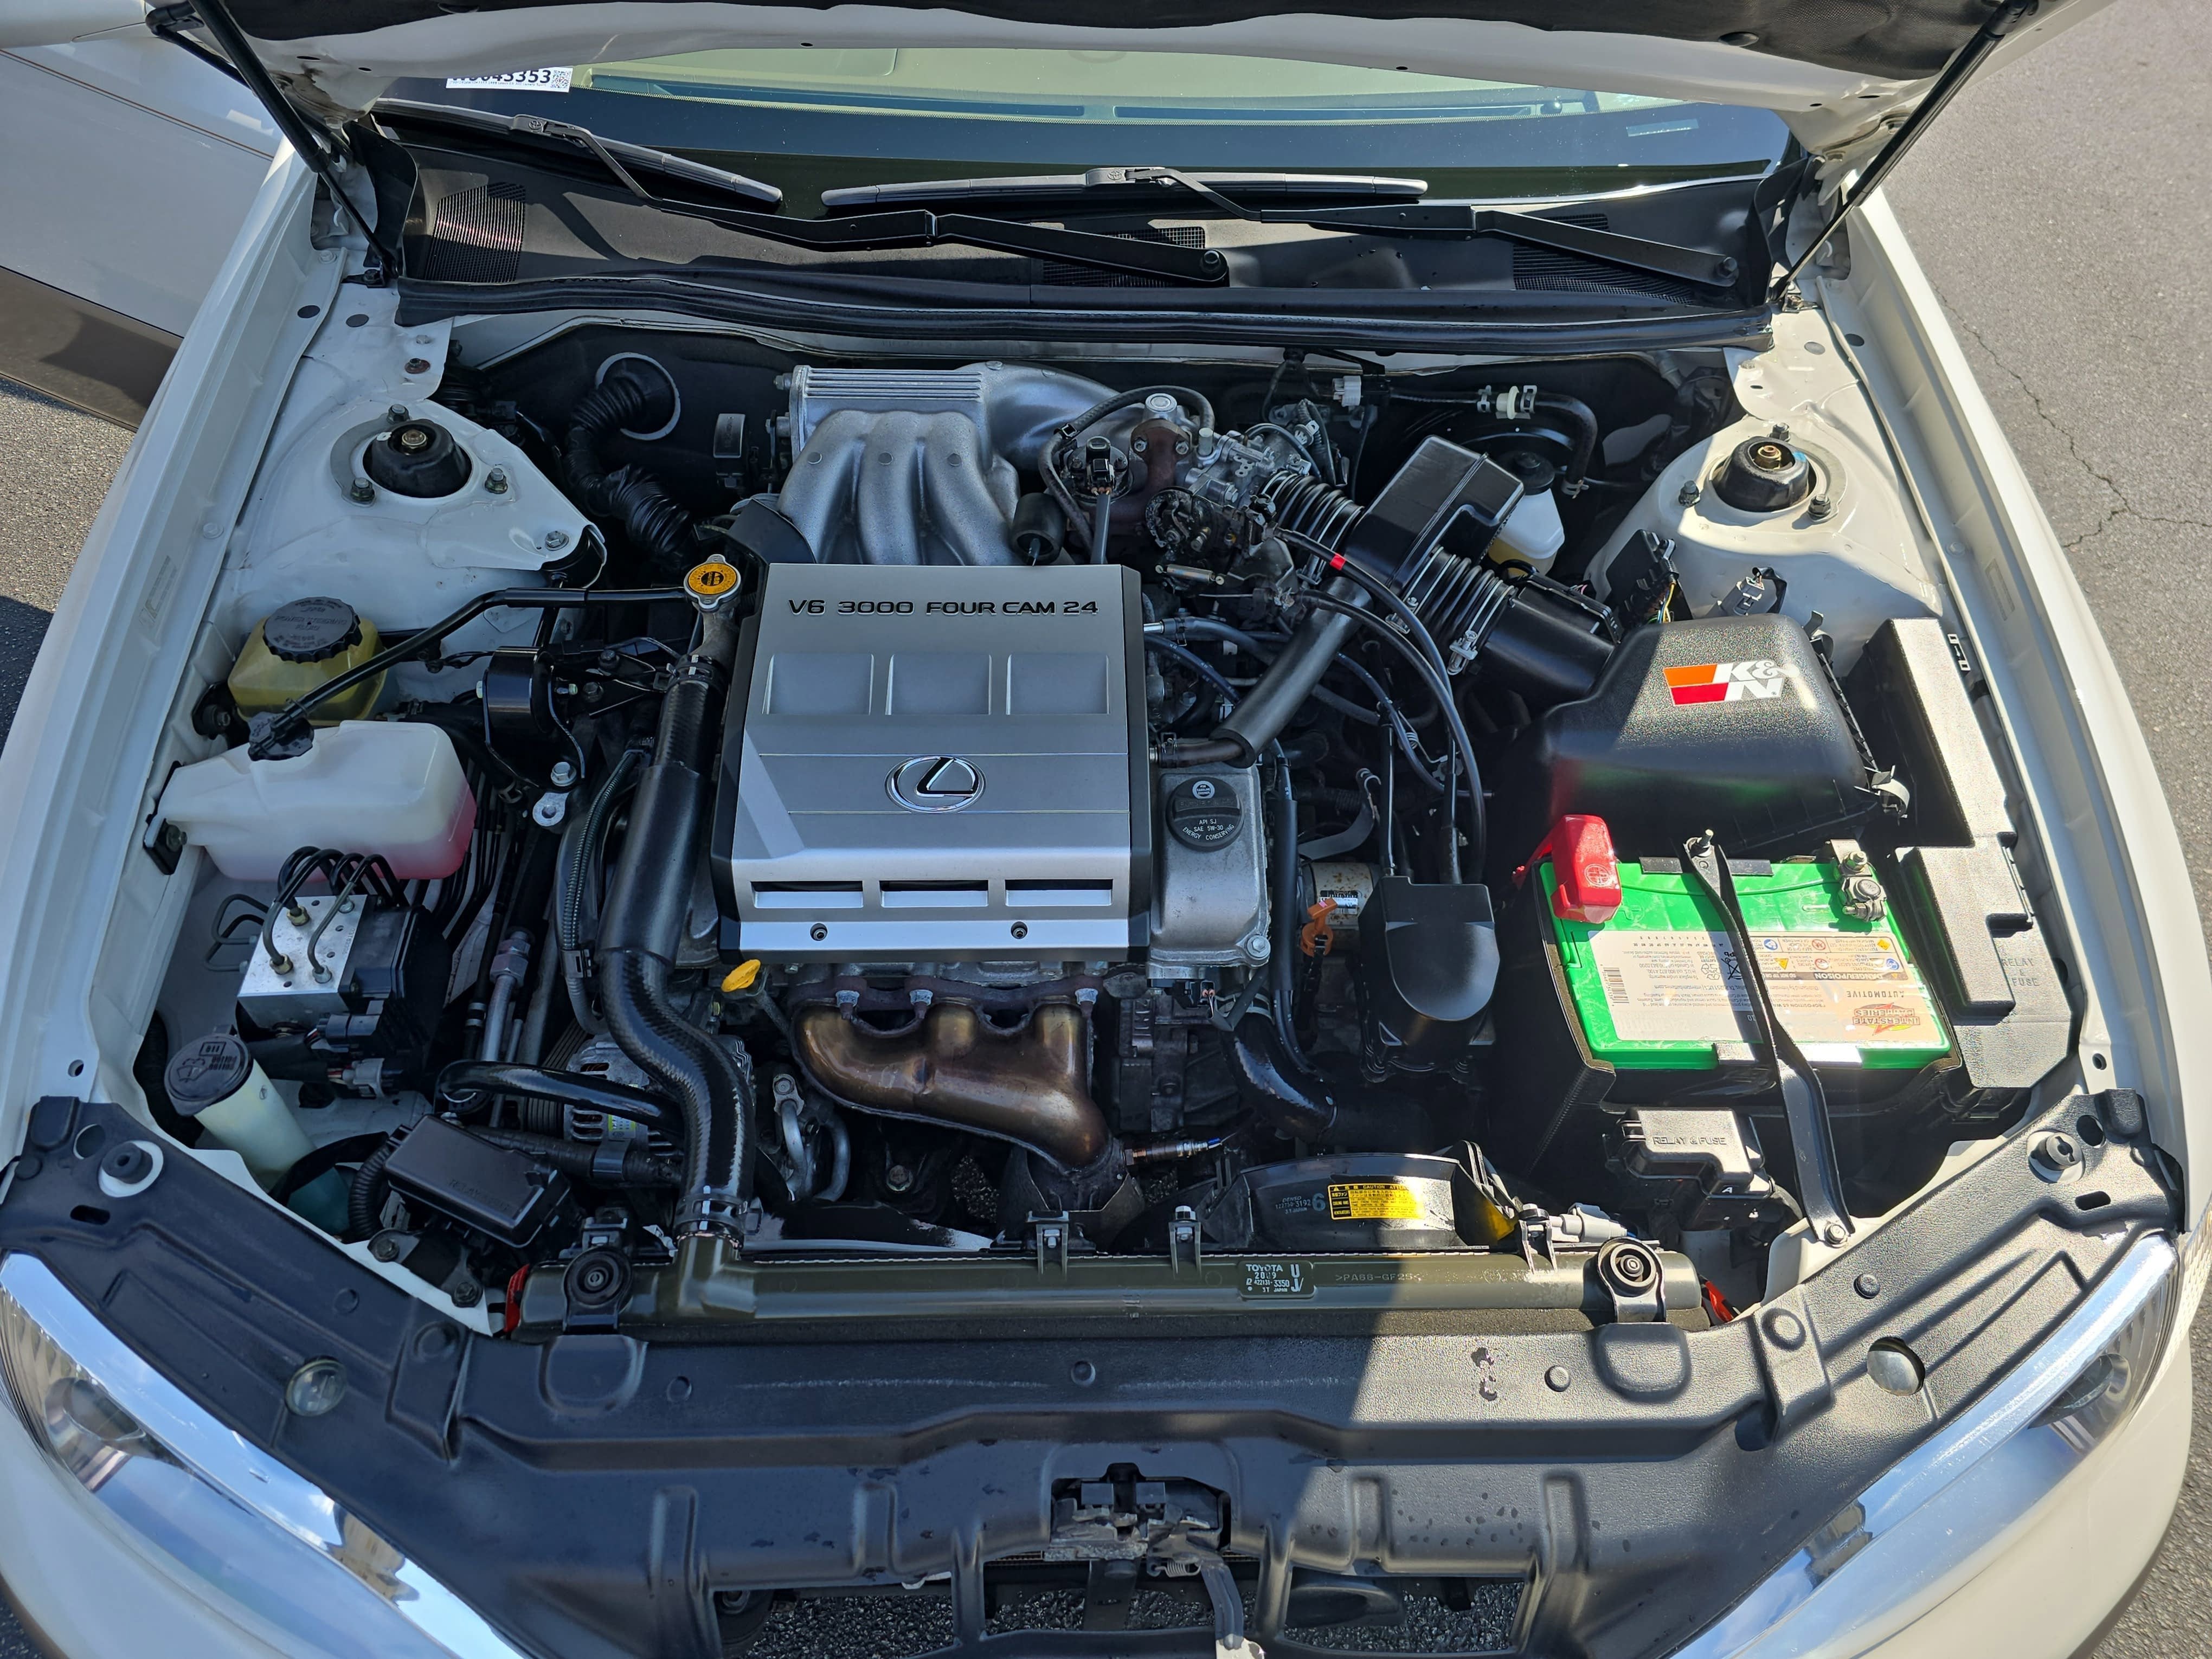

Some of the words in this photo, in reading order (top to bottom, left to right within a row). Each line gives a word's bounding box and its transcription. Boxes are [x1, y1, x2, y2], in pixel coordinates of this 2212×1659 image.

[789, 600, 825, 615] V6
[838, 601, 915, 615] 3000
[926, 601, 996, 615] FOUR
[1002, 601, 1056, 615] CAM
[1063, 601, 1099, 615] 24
[1182, 827, 1201, 839] ENERGY
[1205, 824, 1234, 840] CONSERVING
[2011, 978, 2039, 986] FUSE
[1699, 1137, 1727, 1145] FUSE
[1312, 1193, 1326, 1212] 6
[1245, 1264, 1283, 1272] TOYOTA
